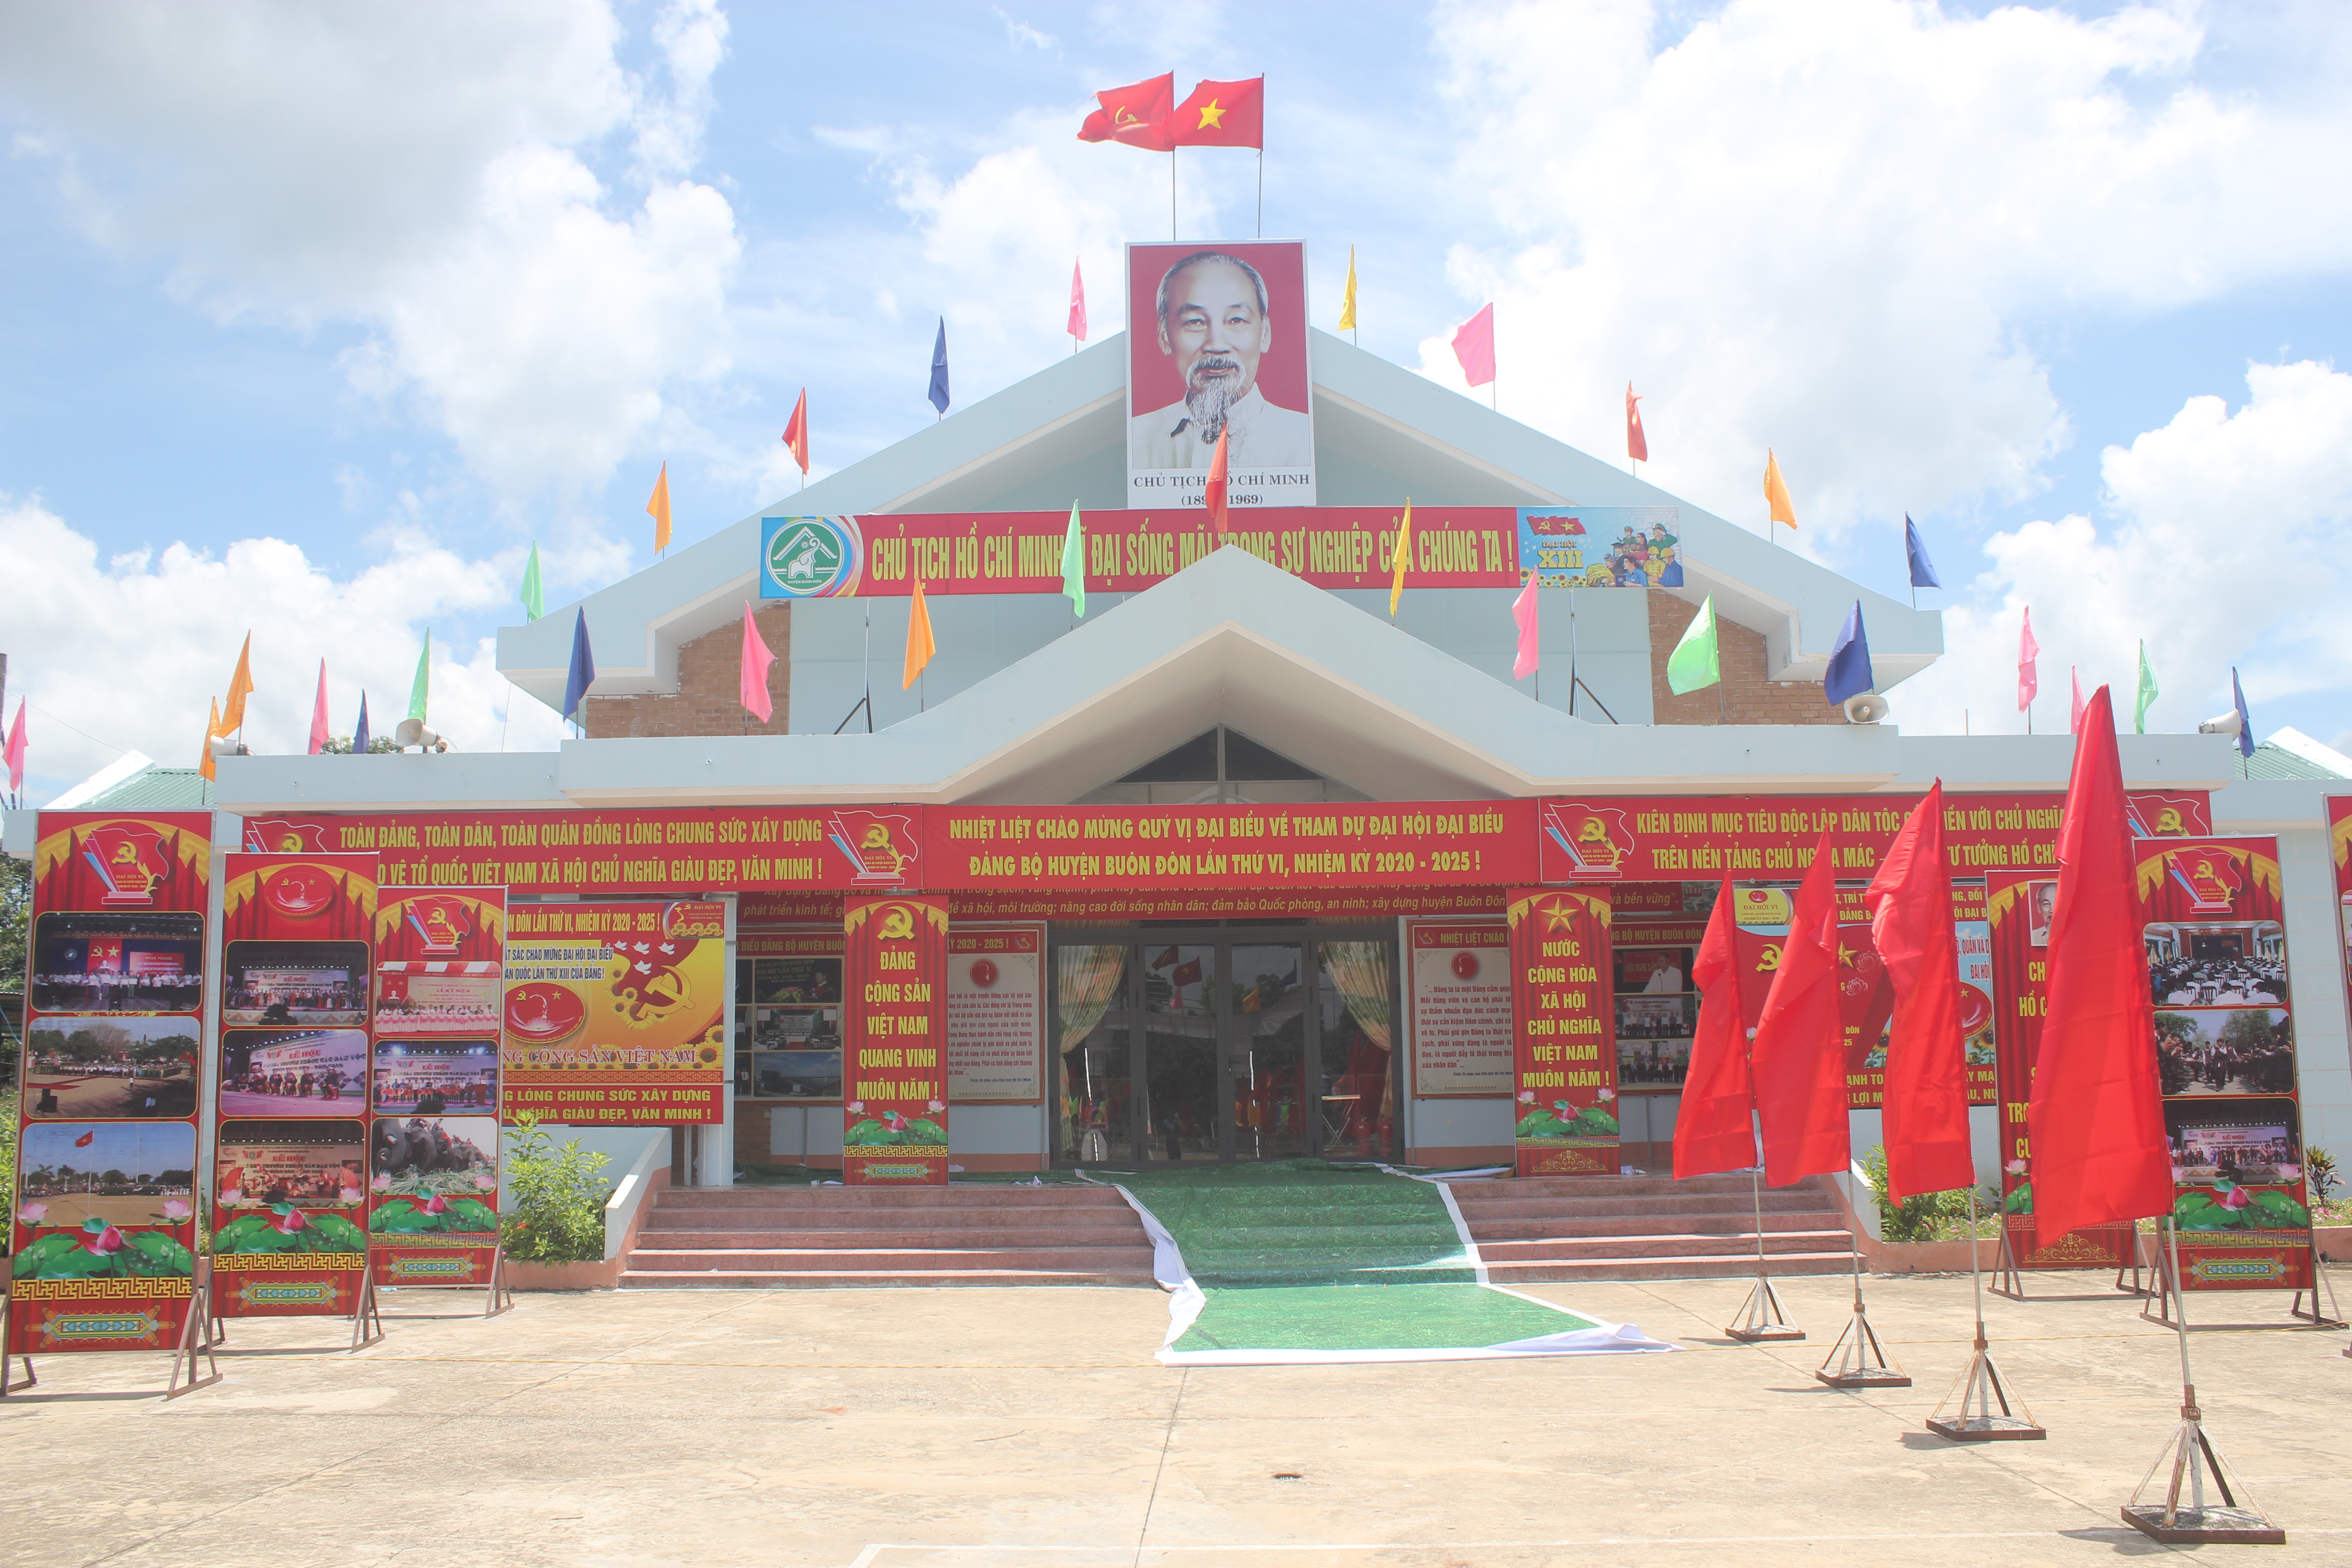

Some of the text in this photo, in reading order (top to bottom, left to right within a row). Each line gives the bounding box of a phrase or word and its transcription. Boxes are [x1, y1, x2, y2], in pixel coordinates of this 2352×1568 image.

[1134, 472, 1308, 489] CHỦ TỊCH CHÍ MINH
[1229, 495, 1263, 505] 1969)
[872, 518, 1503, 589] CHỦ TỊCH HỒ CHÍ ĐẠI SỐNG NGHIỆP CHÚNG TA
[1538, 550, 1583, 569] XIII
[951, 807, 1503, 843] NHIỆT LIỆT CHÀO MỪNG QUÝ VỊ ĐẠI BIỂU VỀ THAM DỰ ĐẠI HỘI ĐẠI BIỂU
[1637, 803, 2022, 838] KIÊN ĐỊNH MỤC TIÊU ĐỘC DÂN TỘC VỚI CHỦ
[340, 817, 822, 849] TOÀN ĐẢNG, TOÀN DÂN, TOÀN QUÂN ĐỒNG LÒNG CHUNG SỨC XÂY DỰNG
[970, 848, 1470, 881] ĐẢNG BỘ HUYỆN BUÔN ĐÔN LẦN THỨ VI, NHIỆM KỲ 2020 2025
[1652, 838, 2029, 869] TRÊN NỀN TẢNG CHỦ MÁC TƯỞNG HỒ
[411, 854, 812, 887] TỔ QUỐC NAM XÃ HỘI CHỦ NGHĨA GIÀU ĐẸP, VĂN MINH
[1060, 901, 1086, 915] nâng
[1110, 901, 1126, 911] đời
[1129, 899, 1154, 914] sống
[1157, 901, 1182, 911] nhân
[1186, 900, 1208, 913] dân;
[1212, 898, 1233, 910] đảm
[1237, 898, 1256, 910] bảo
[1259, 897, 1285, 910] Quốc
[1289, 898, 1323, 912] phòng,
[1343, 898, 1368, 909] ninh;
[1372, 900, 1390, 910] xây
[1393, 897, 1418, 910] dựng
[1422, 896, 1452, 910] huyện
[1456, 896, 1482, 906] Buôn
[1486, 895, 1505, 906] Đôn
[516, 908, 655, 935] ĐÔN LẦN THỨ VI, NHIỆM KỲ 2020 2025
[1441, 931, 1504, 945] NHIỆT LIỆT CHÀO
[1543, 939, 1580, 956] NƯỚC
[513, 944, 612, 962] SẮC CHÀO MỪNG ĐẠI HỘI ĐẠI BIỂU
[880, 946, 915, 970] ĐẢNG
[1528, 964, 1597, 986] CỘNG HÒA
[865, 978, 930, 1006] CỘNG SẢN
[1541, 990, 1586, 1011] XÃ HỘI
[867, 1013, 927, 1039] VIỆT NAM
[1528, 1015, 1602, 1035] CHỦ NGHĨA
[529, 1044, 696, 1067] CỘNG SẢN VIỆT NAM
[859, 1049, 936, 1069] QUANG VINH
[1533, 1043, 1597, 1064] VIỆT NAM
[1523, 1069, 1564, 1087] MUÔN
[1568, 1068, 1600, 1086] NĂM
[857, 1078, 929, 1100] MUÔN NĂM
